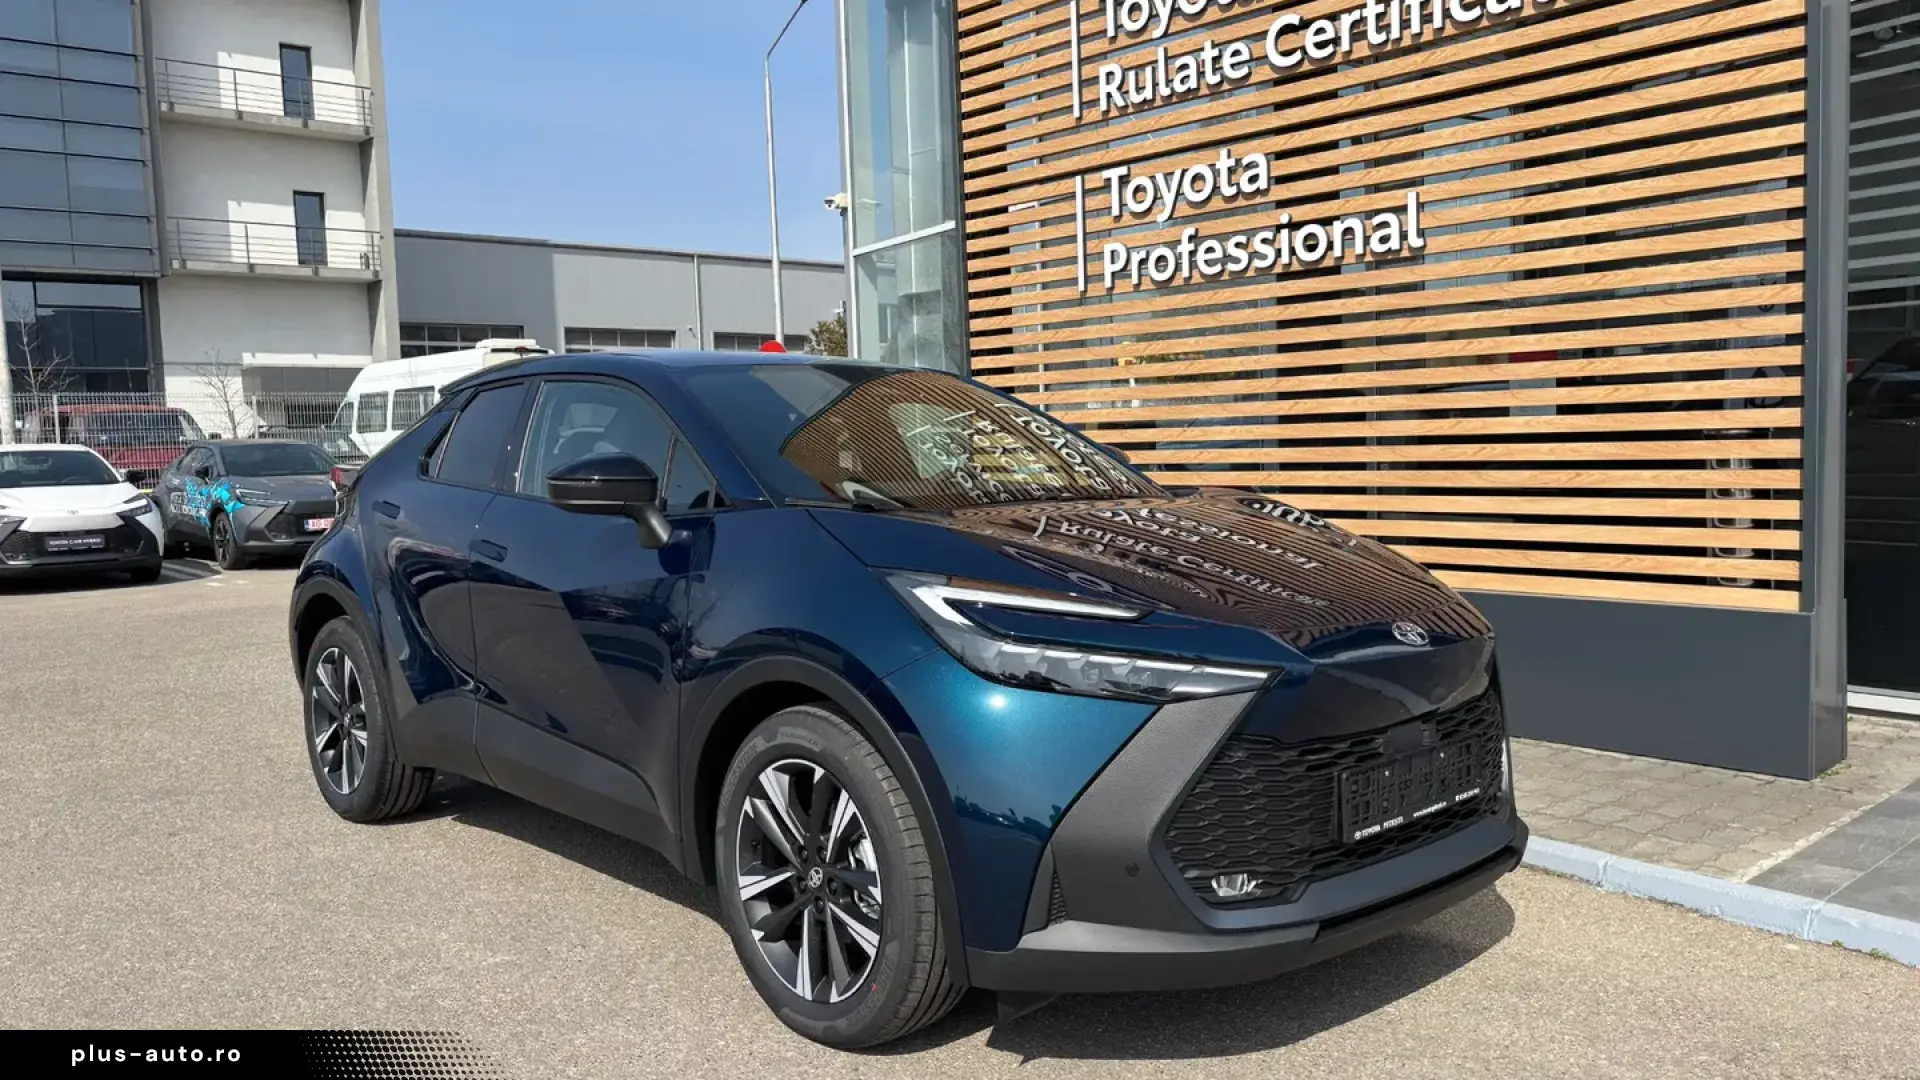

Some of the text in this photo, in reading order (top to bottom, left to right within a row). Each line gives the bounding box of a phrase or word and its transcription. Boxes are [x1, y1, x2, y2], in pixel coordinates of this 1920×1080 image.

[1099, 39, 1251, 112] Rulate
[1101, 148, 1269, 223] Toyota
[1103, 191, 1425, 289] Professional
